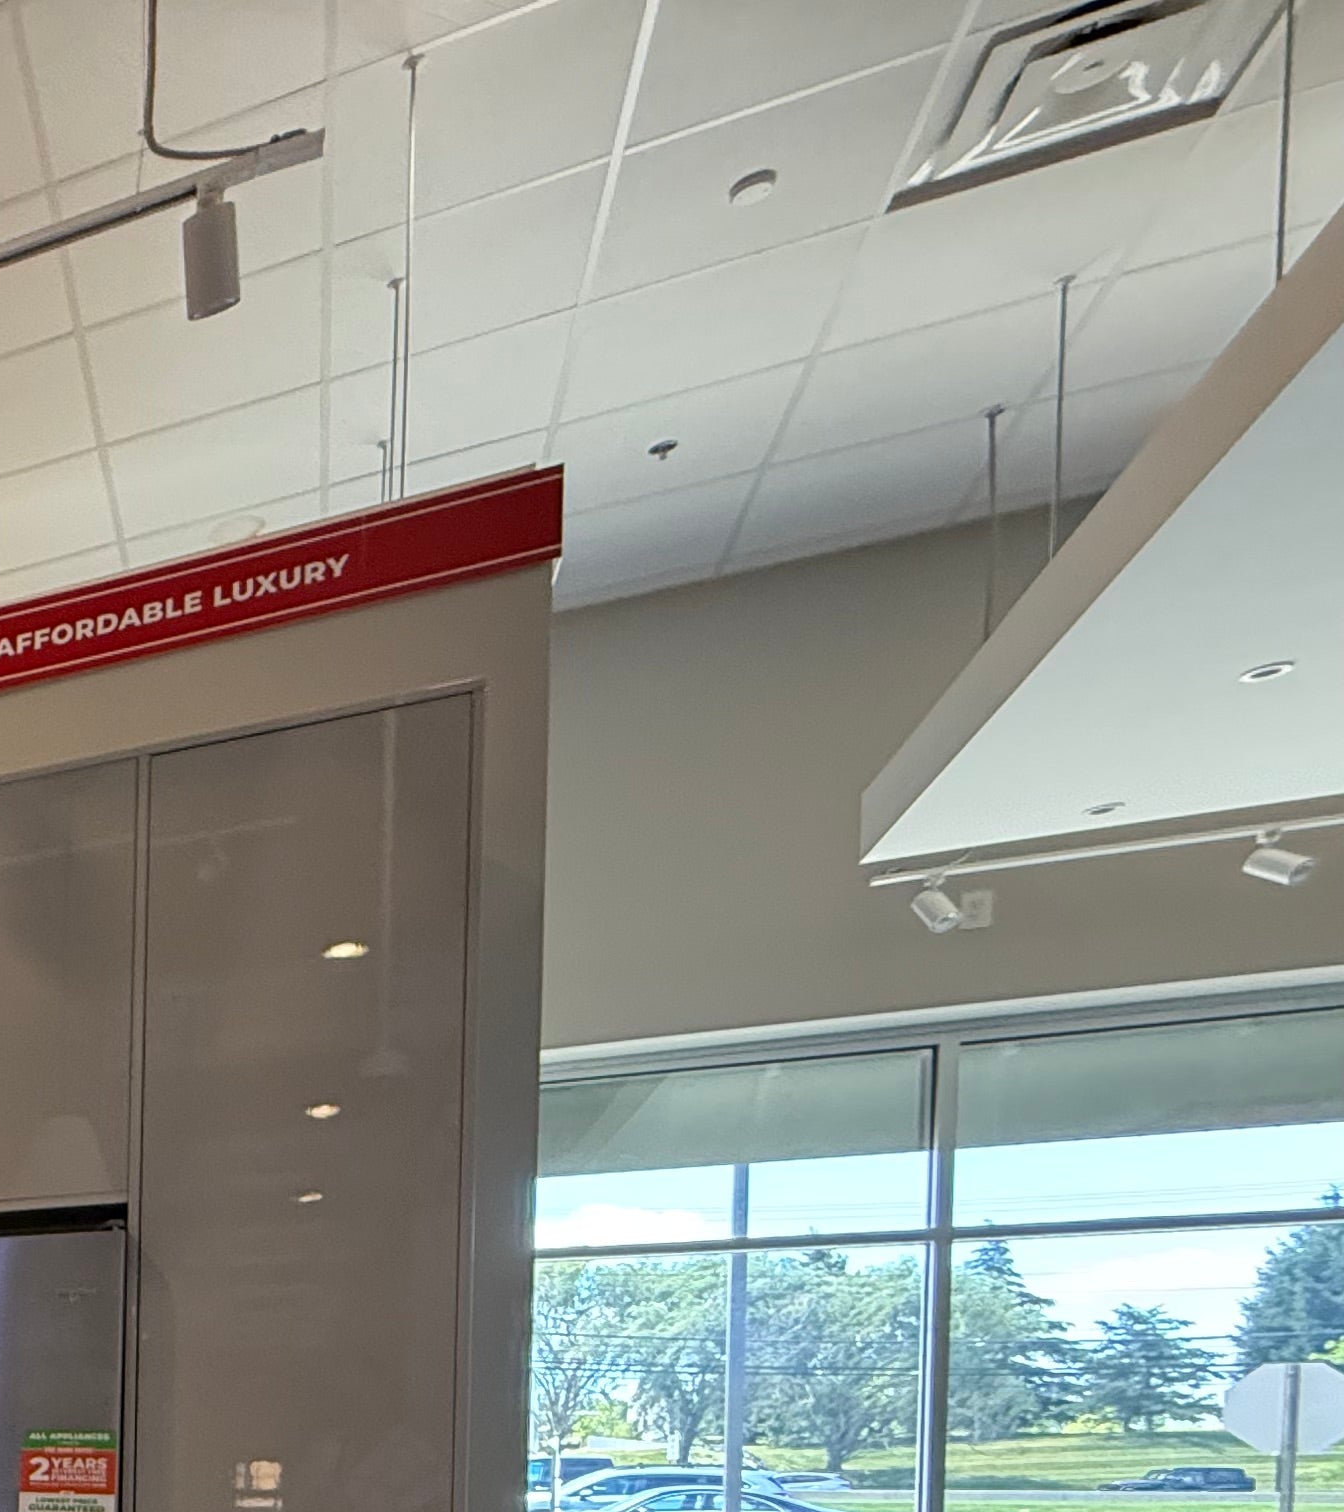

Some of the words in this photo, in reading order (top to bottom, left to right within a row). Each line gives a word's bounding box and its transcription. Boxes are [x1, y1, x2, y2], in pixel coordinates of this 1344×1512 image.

[213, 554, 350, 608] LUXURY
[29, 1456, 50, 1481] 2
[50, 1457, 107, 1469] YEARS
